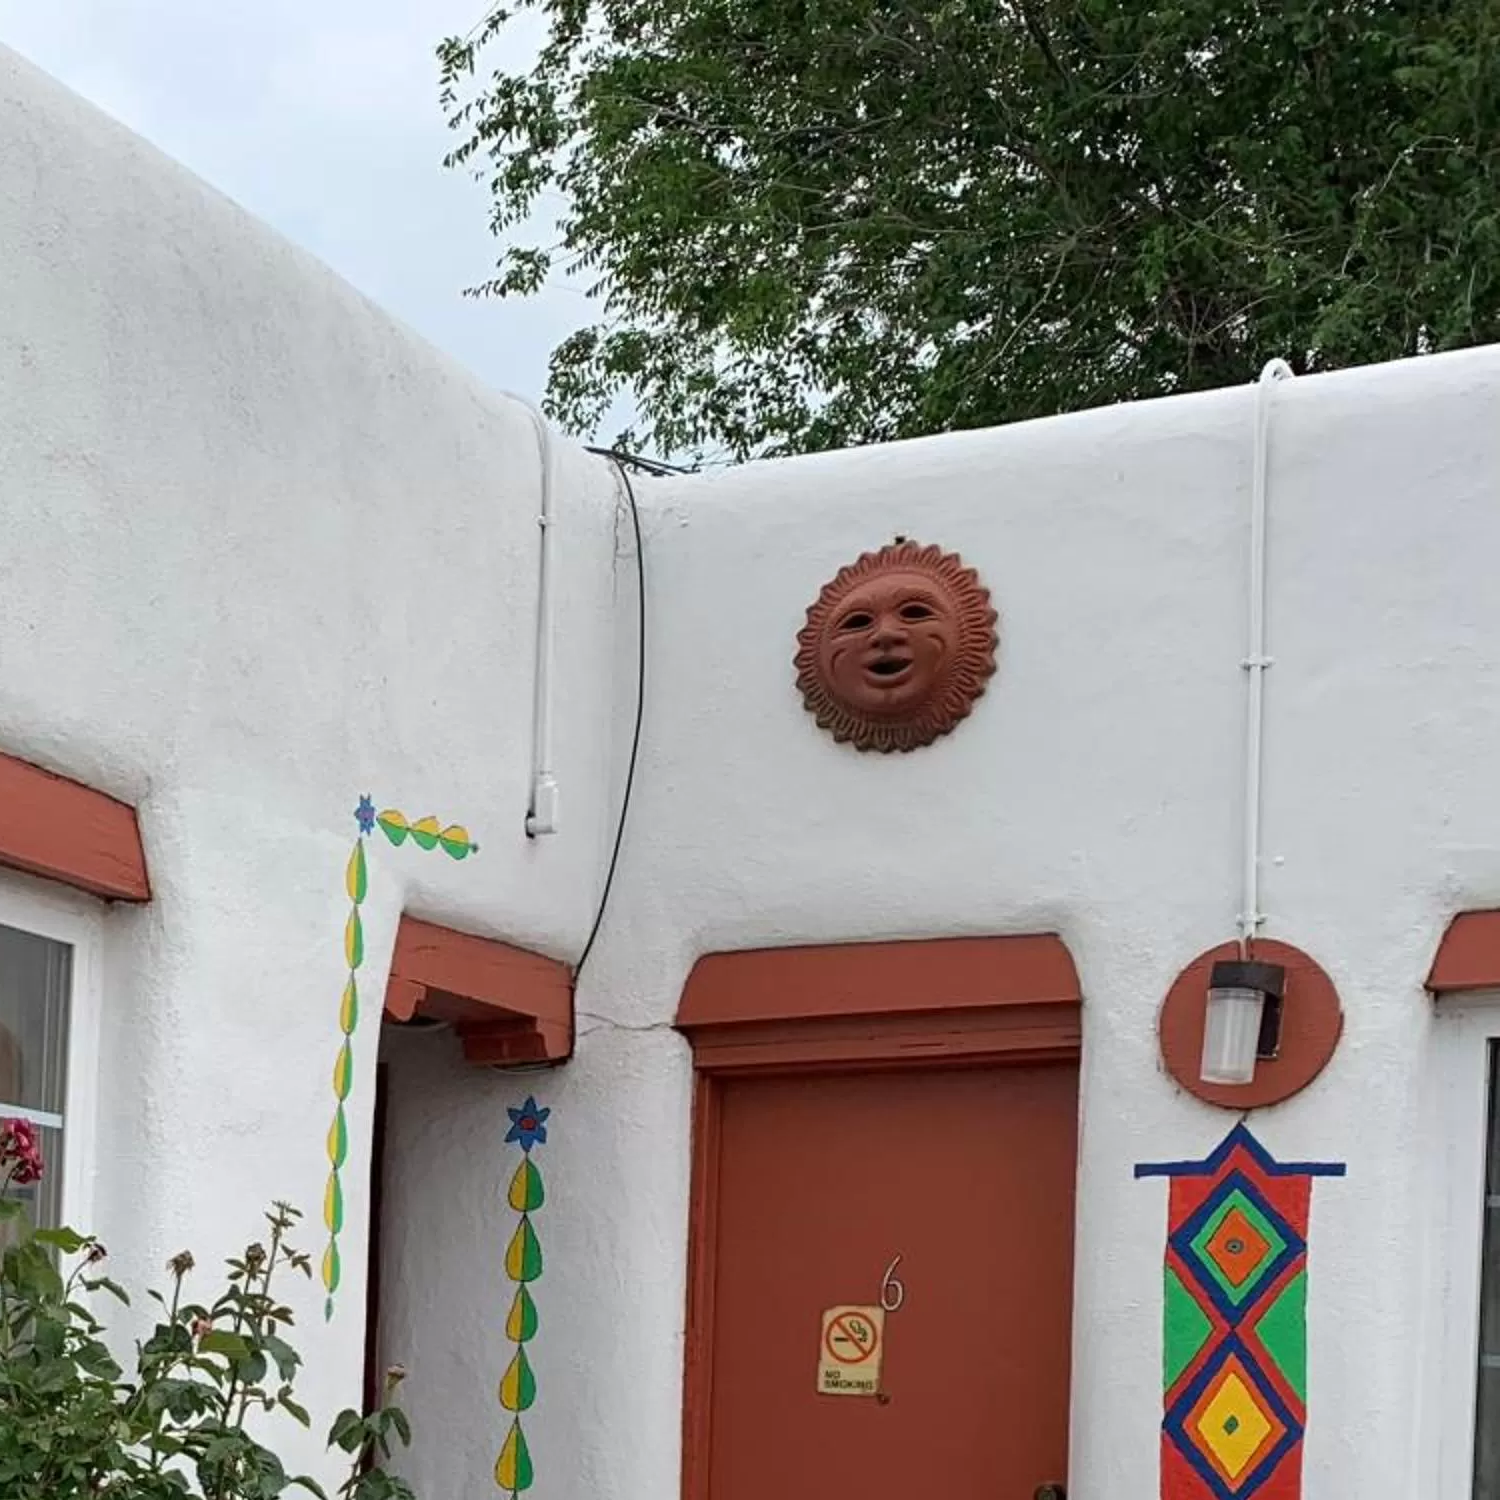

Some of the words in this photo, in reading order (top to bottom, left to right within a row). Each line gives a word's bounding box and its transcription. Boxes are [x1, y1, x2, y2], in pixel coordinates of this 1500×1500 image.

[881, 1254, 904, 1311] 6
[825, 1370, 841, 1379] NO
[824, 1379, 873, 1390] SMOKING
